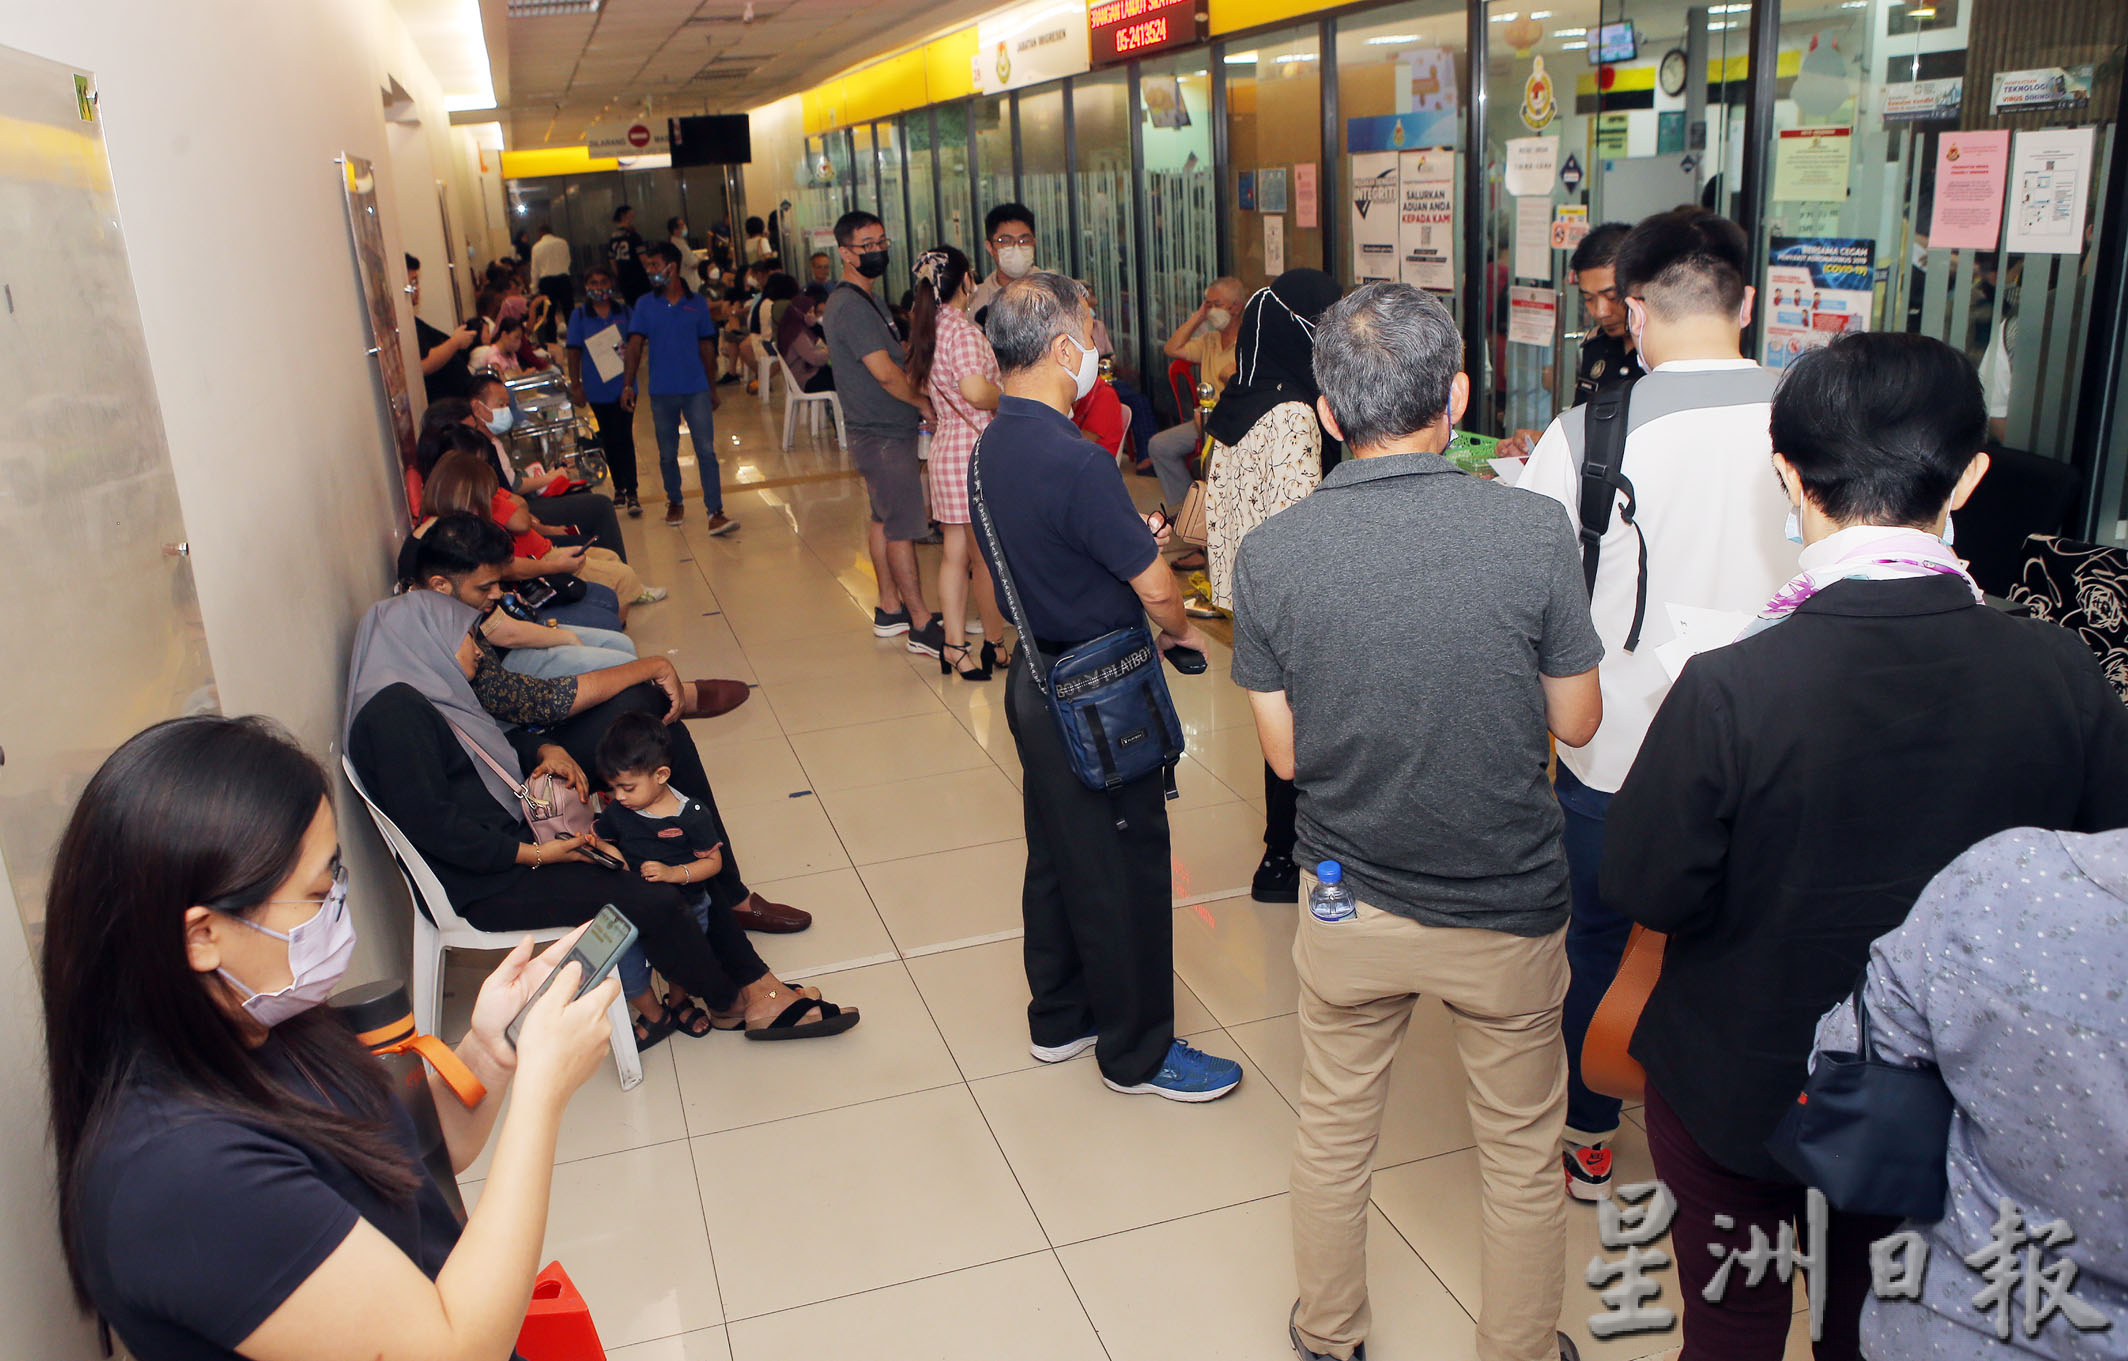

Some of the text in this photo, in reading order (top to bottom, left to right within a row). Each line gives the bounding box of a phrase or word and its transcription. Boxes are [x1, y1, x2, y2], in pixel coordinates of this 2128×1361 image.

[1116, 17, 1167, 52] 05-2413524
[1407, 190, 1445, 200] SALURKAN
[1403, 201, 1451, 212] ADUAN ANDA
[1402, 214, 1451, 224] KEPADA KAMI
[1802, 246, 1839, 255] BERSAMA
[1823, 264, 1868, 276] (COVID-19)
[1102, 646, 1152, 682] PLAYBOY
